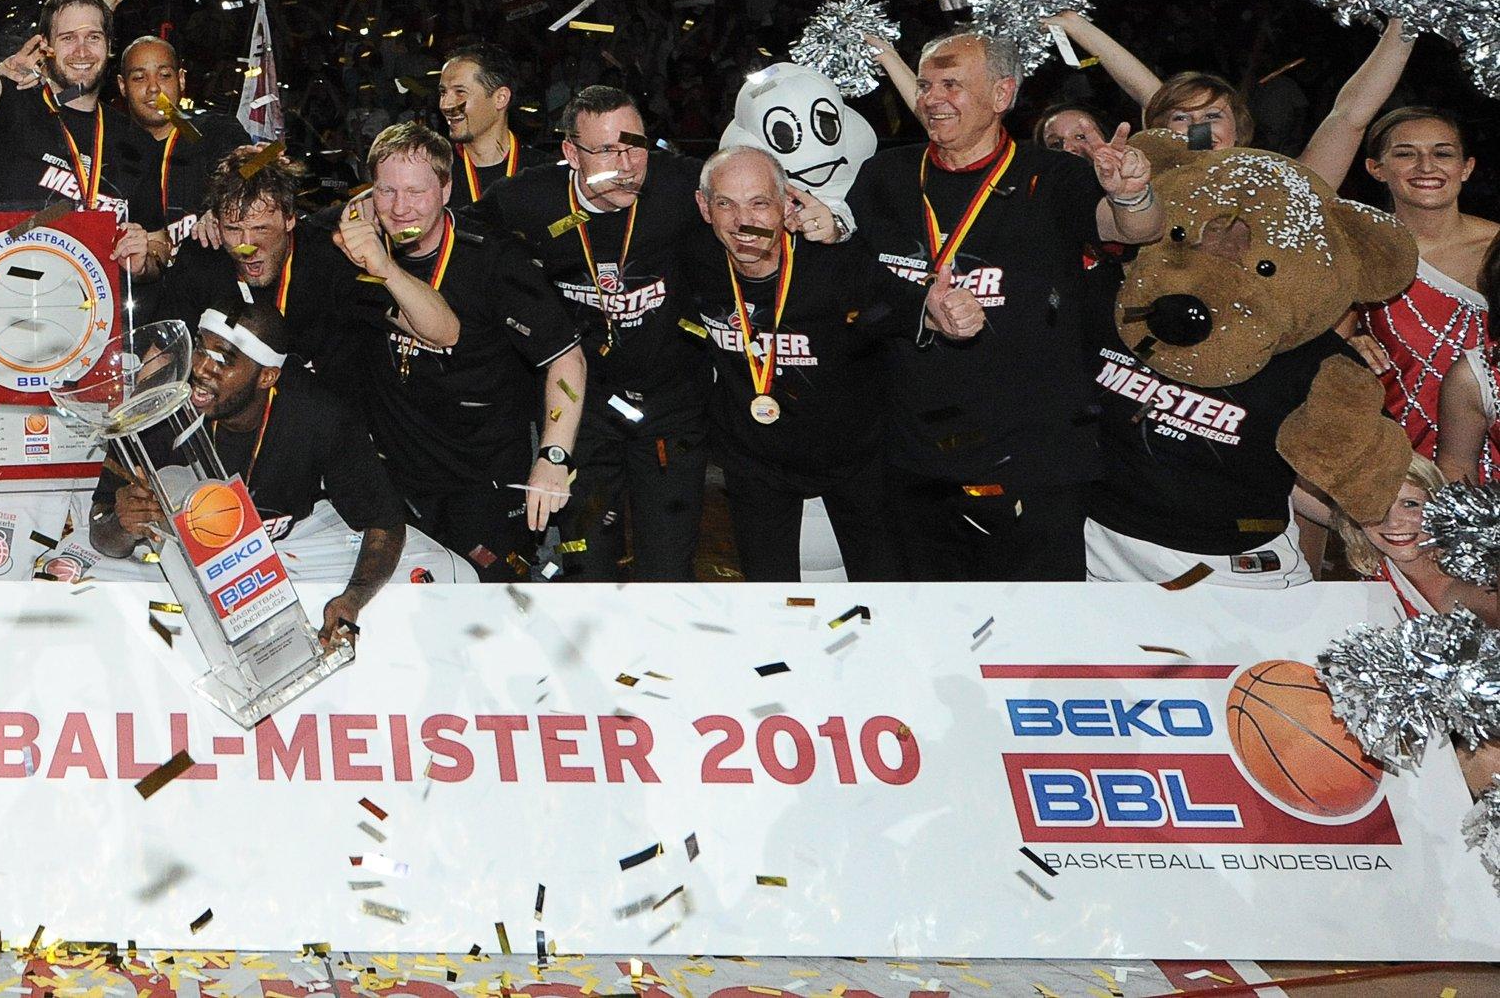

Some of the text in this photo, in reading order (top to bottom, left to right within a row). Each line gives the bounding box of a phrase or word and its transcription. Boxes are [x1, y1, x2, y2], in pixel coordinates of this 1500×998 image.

[78, 253, 107, 301] MEISTER
[879, 253, 928, 270] DEUTSCHER
[1096, 361, 1248, 433] MEISTER
[1147, 410, 1241, 446] & POKALSIEGER
[1154, 425, 1187, 442] 2010
[206, 538, 263, 581] BEKO
[218, 569, 277, 609] BBL
[229, 588, 284, 626] BASKETBALL
[232, 595, 288, 633] BUNDESLIGA
[1005, 698, 1213, 737] BEKO
[691, 714, 921, 785] 2010
[1026, 771, 1240, 824] BBL
[1043, 852, 1393, 871] BASKETBALL BUNDESLIGA
